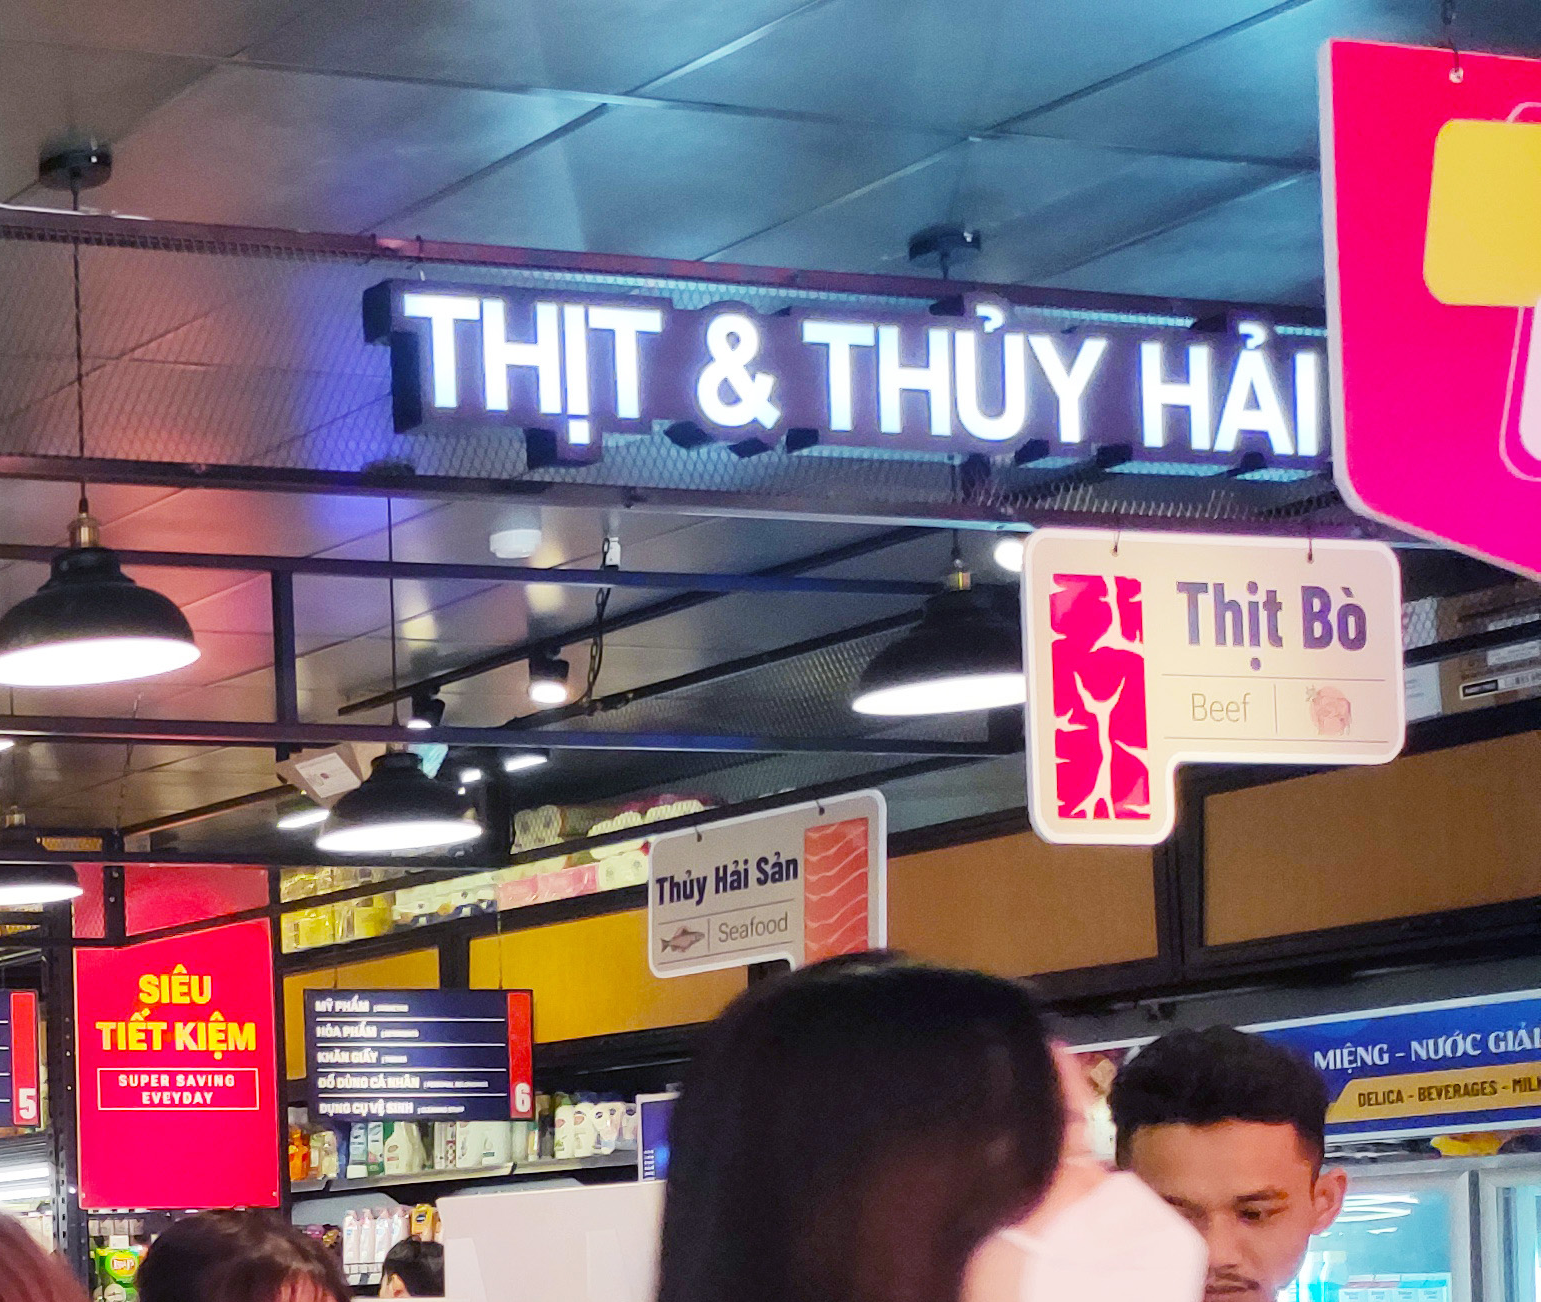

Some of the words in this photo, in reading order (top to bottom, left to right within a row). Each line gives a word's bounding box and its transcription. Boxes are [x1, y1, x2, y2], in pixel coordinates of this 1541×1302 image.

[403, 293, 663, 446] THỊT
[696, 312, 779, 429] &
[803, 306, 1104, 444] THỦY
[1141, 323, 1318, 455] HẢI
[1176, 581, 1284, 670] Thịt
[1301, 585, 1367, 651] Bò
[1191, 692, 1252, 725] Beef
[655, 870, 707, 908] Thủy
[714, 860, 749, 896] Hải
[756, 852, 798, 887] Sản
[718, 912, 788, 944] Seafood
[138, 964, 212, 1005] SIÊU
[96, 1008, 167, 1051] TIẾT
[176, 1011, 256, 1060] KIỆM
[1314, 1042, 1389, 1073] MIỆNG
[1411, 1030, 1482, 1062] NƯỚC
[118, 1074, 169, 1088] SUPER
[176, 1074, 235, 1088] SAVING
[515, 1083, 531, 1112] 6
[1358, 1090, 1404, 1108] DELICA
[1417, 1080, 1497, 1101] BEVERAGES
[19, 1088, 37, 1119] 5
[142, 1091, 214, 1105] EVEYDAY
